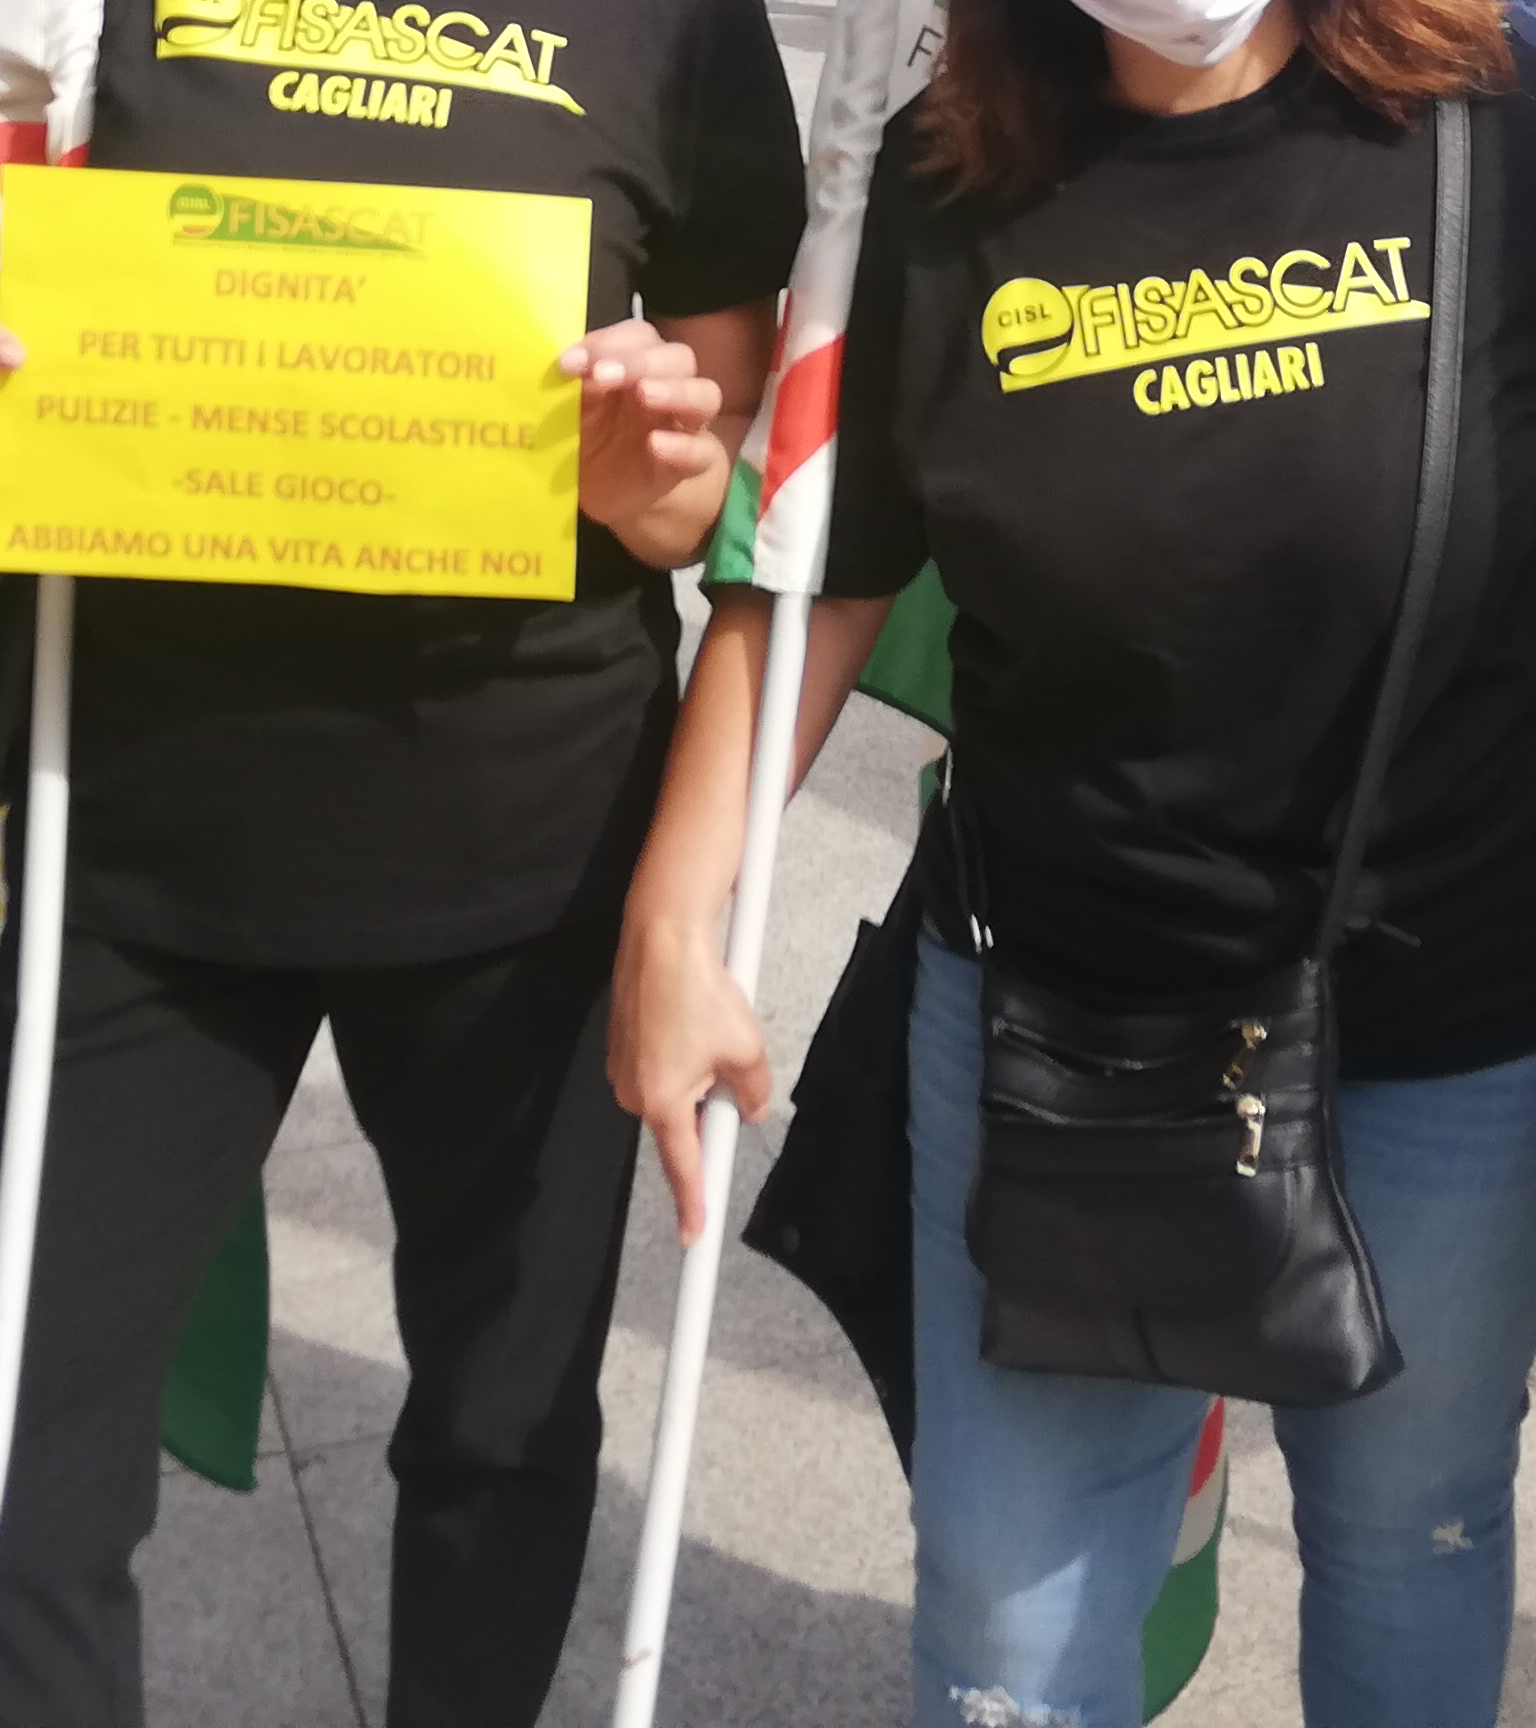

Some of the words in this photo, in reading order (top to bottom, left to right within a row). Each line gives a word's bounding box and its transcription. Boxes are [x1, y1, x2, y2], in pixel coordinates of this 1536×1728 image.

[268, 70, 453, 128] CAGLIARI
[227, 198, 437, 246] FISASCAT
[213, 266, 369, 306] DIGNITA'
[1076, 235, 1413, 358] FISASCAT
[997, 305, 1054, 329] CISL
[77, 327, 141, 363] PER
[151, 333, 249, 369] TUTTI
[255, 339, 267, 369] I
[277, 341, 498, 384] LAVORATORI
[1132, 341, 1327, 417] CAGLIARI
[35, 393, 160, 430] PULIZIE
[190, 403, 310, 440] MENSE
[7, 522, 174, 558] ABBIAMO
[183, 532, 260, 564] UNA
[266, 537, 347, 572] VITA
[354, 542, 472, 578] ANCHE
[481, 549, 544, 579] NOI
